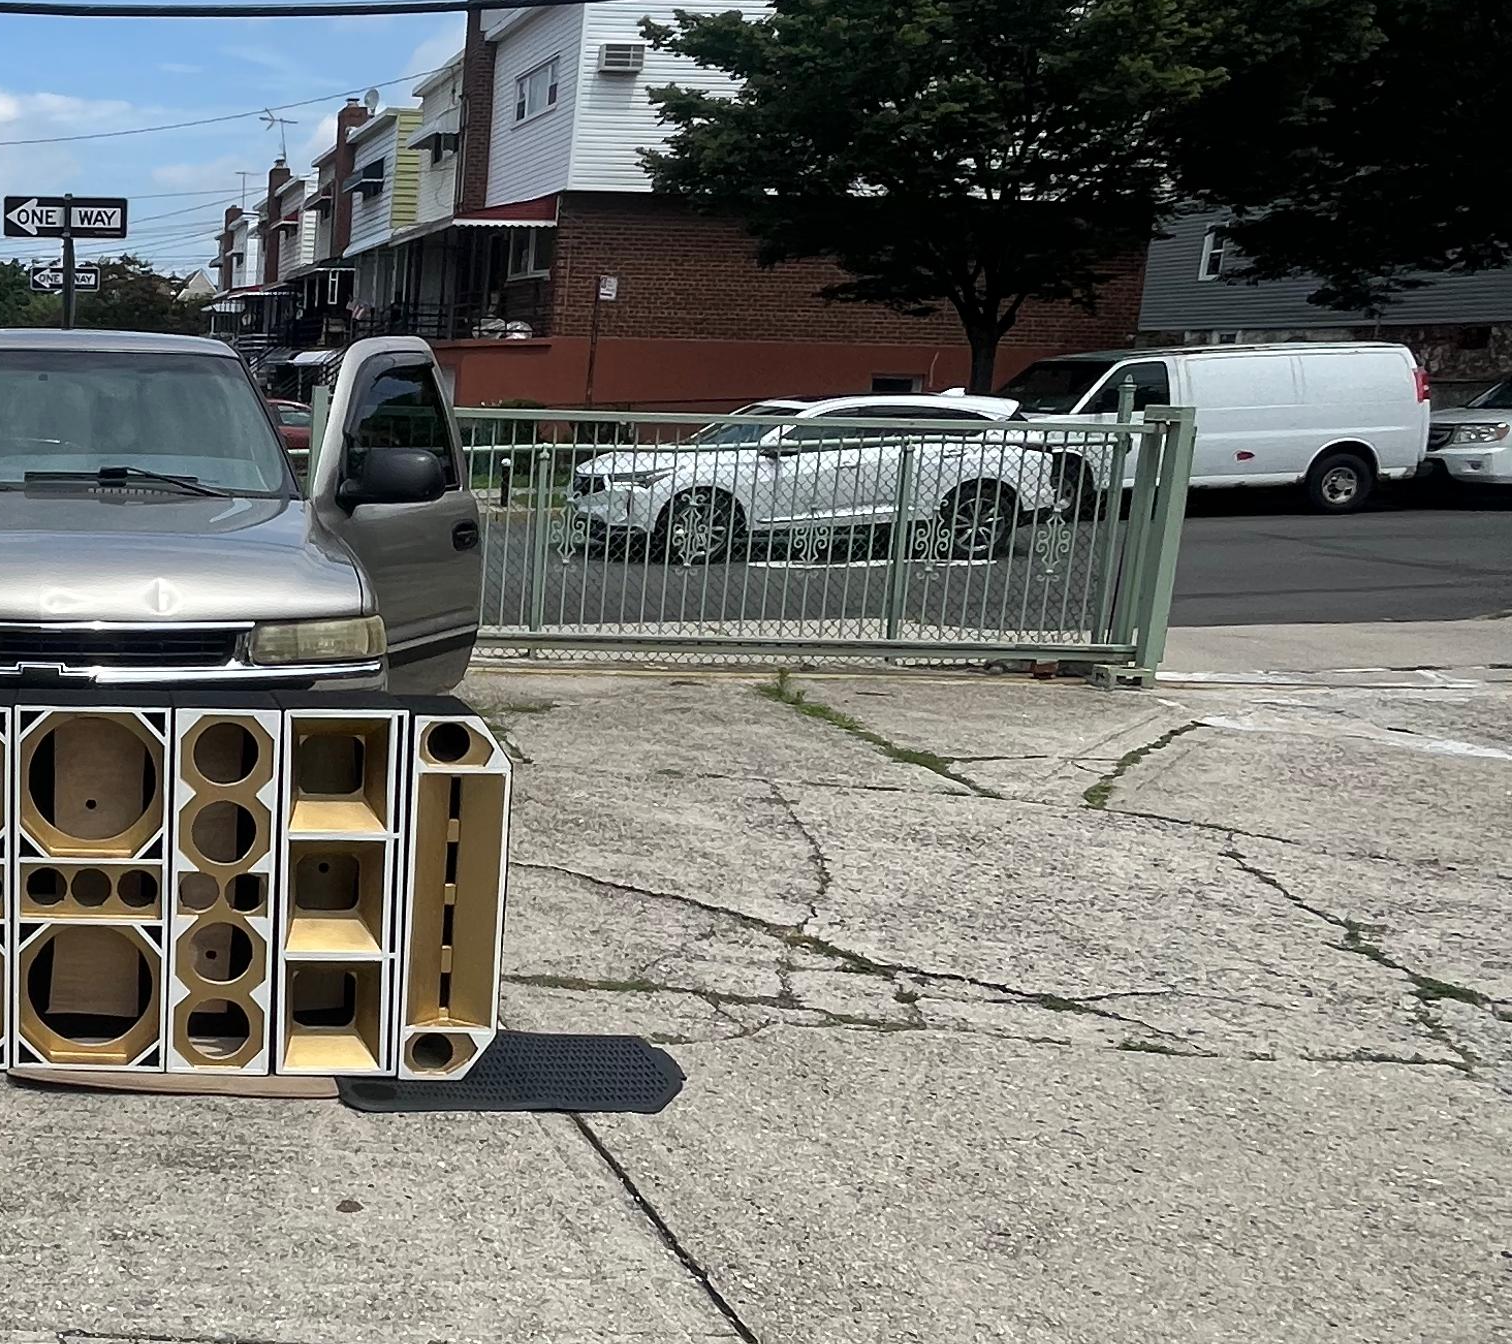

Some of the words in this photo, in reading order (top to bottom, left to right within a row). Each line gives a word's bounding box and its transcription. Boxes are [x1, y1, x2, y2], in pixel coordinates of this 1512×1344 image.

[17, 208, 57, 226] ONE
[78, 209, 117, 227] WAY
[38, 273, 60, 283] ONE
